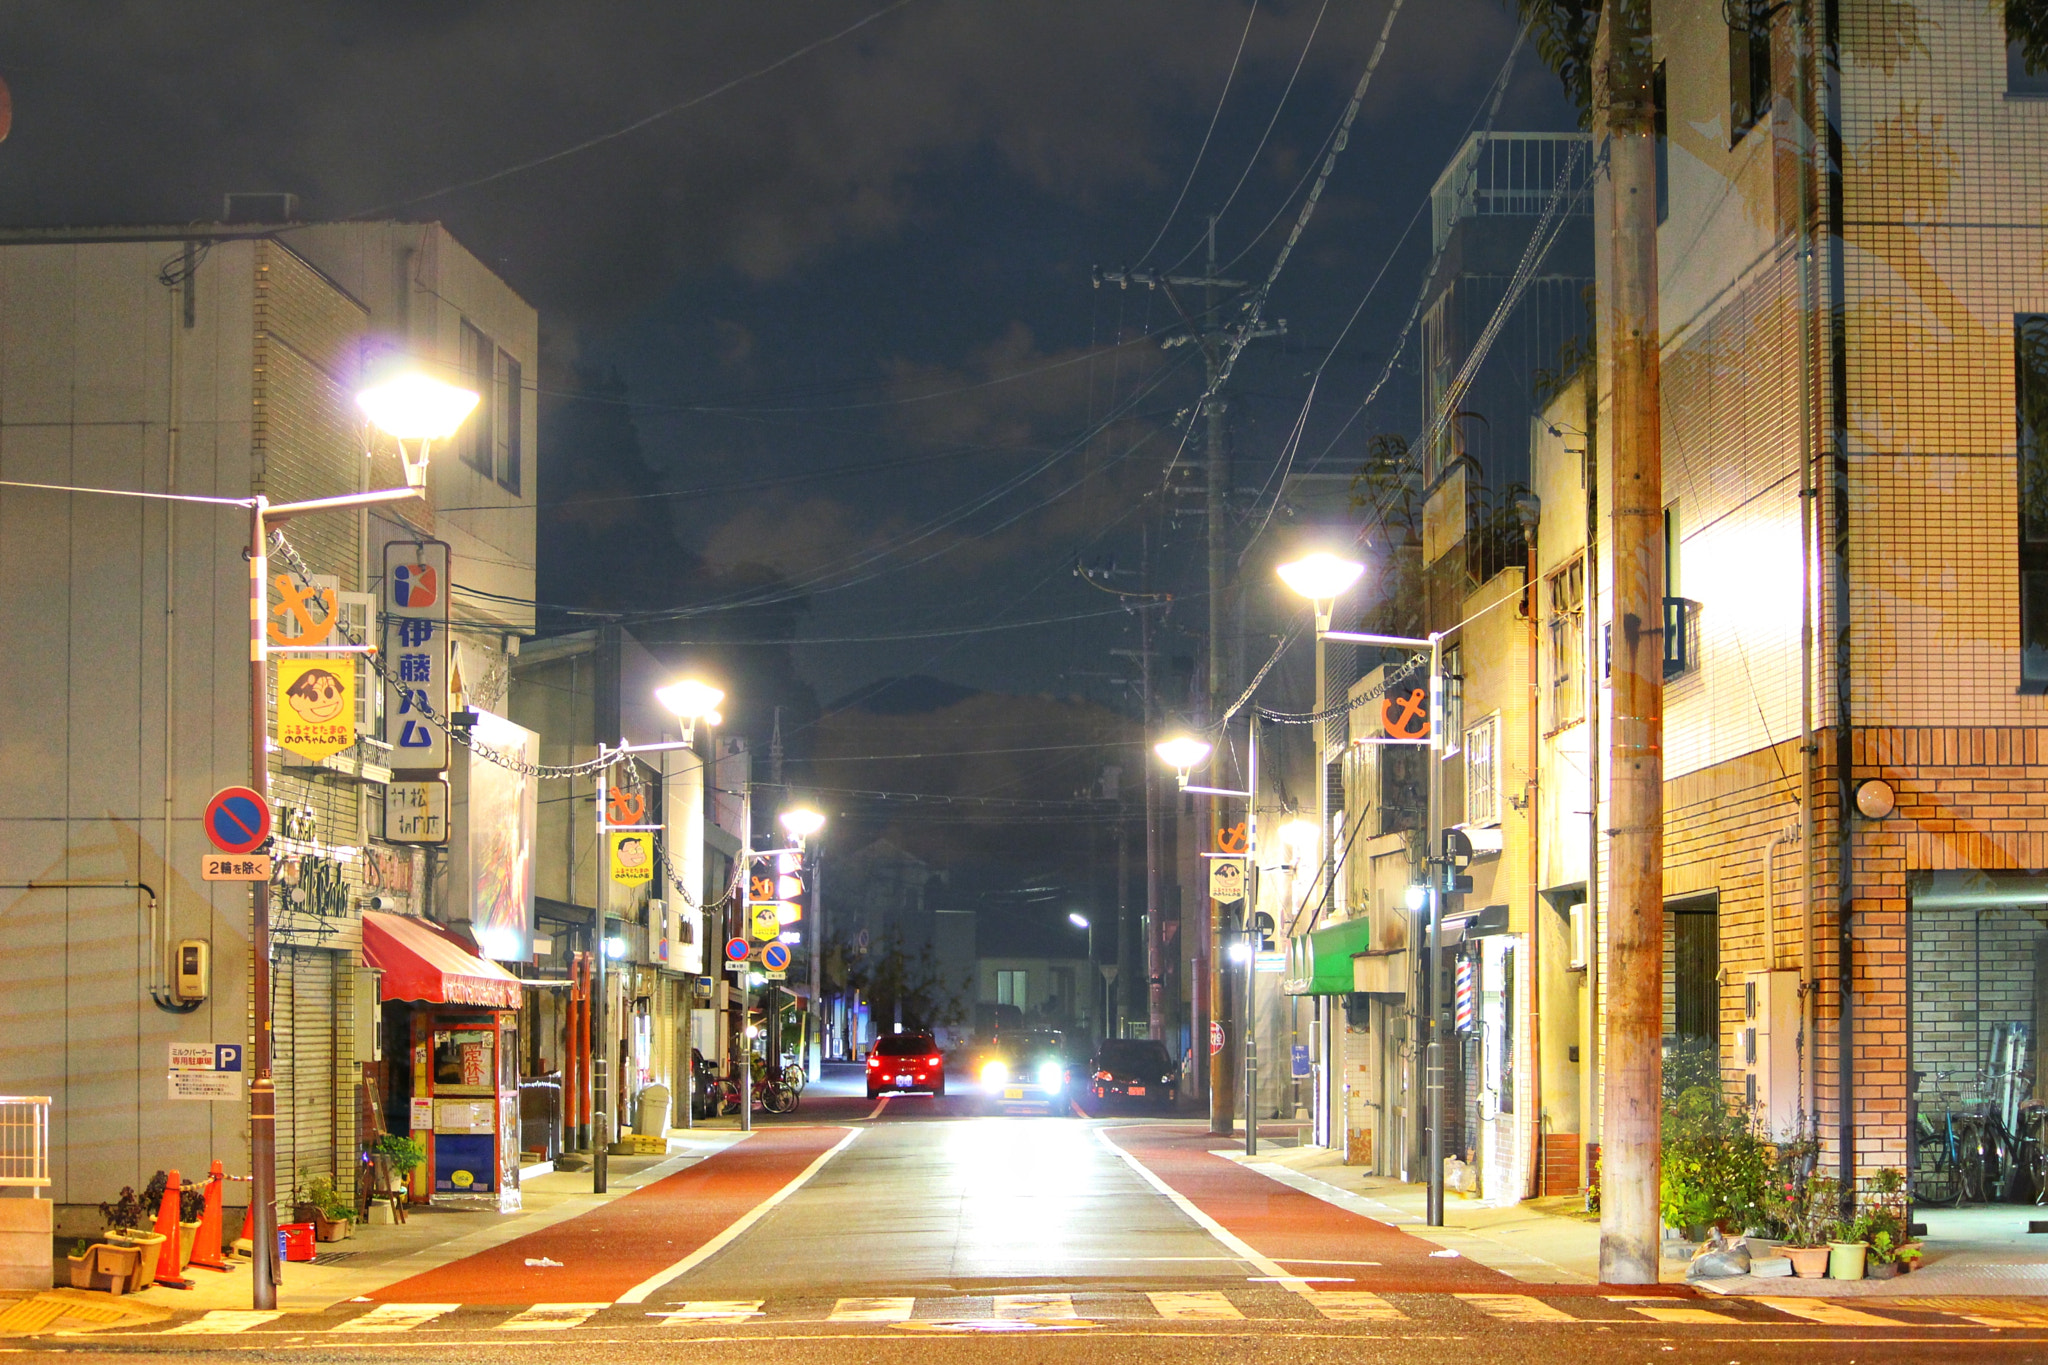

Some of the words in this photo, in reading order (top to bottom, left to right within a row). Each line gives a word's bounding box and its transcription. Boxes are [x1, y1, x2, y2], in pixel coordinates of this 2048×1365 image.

[399, 620, 433, 748] 伊藤ハム
[284, 724, 347, 736] ふるさとたまの
[284, 735, 348, 745] ののちゃんの街
[209, 861, 263, 875] 2輪を除く
[172, 1048, 214, 1056] ミルクパーラー
[220, 1047, 237, 1069] P
[172, 1056, 213, 1065] 専用駐車場
[464, 1048, 485, 1085] 定休日
